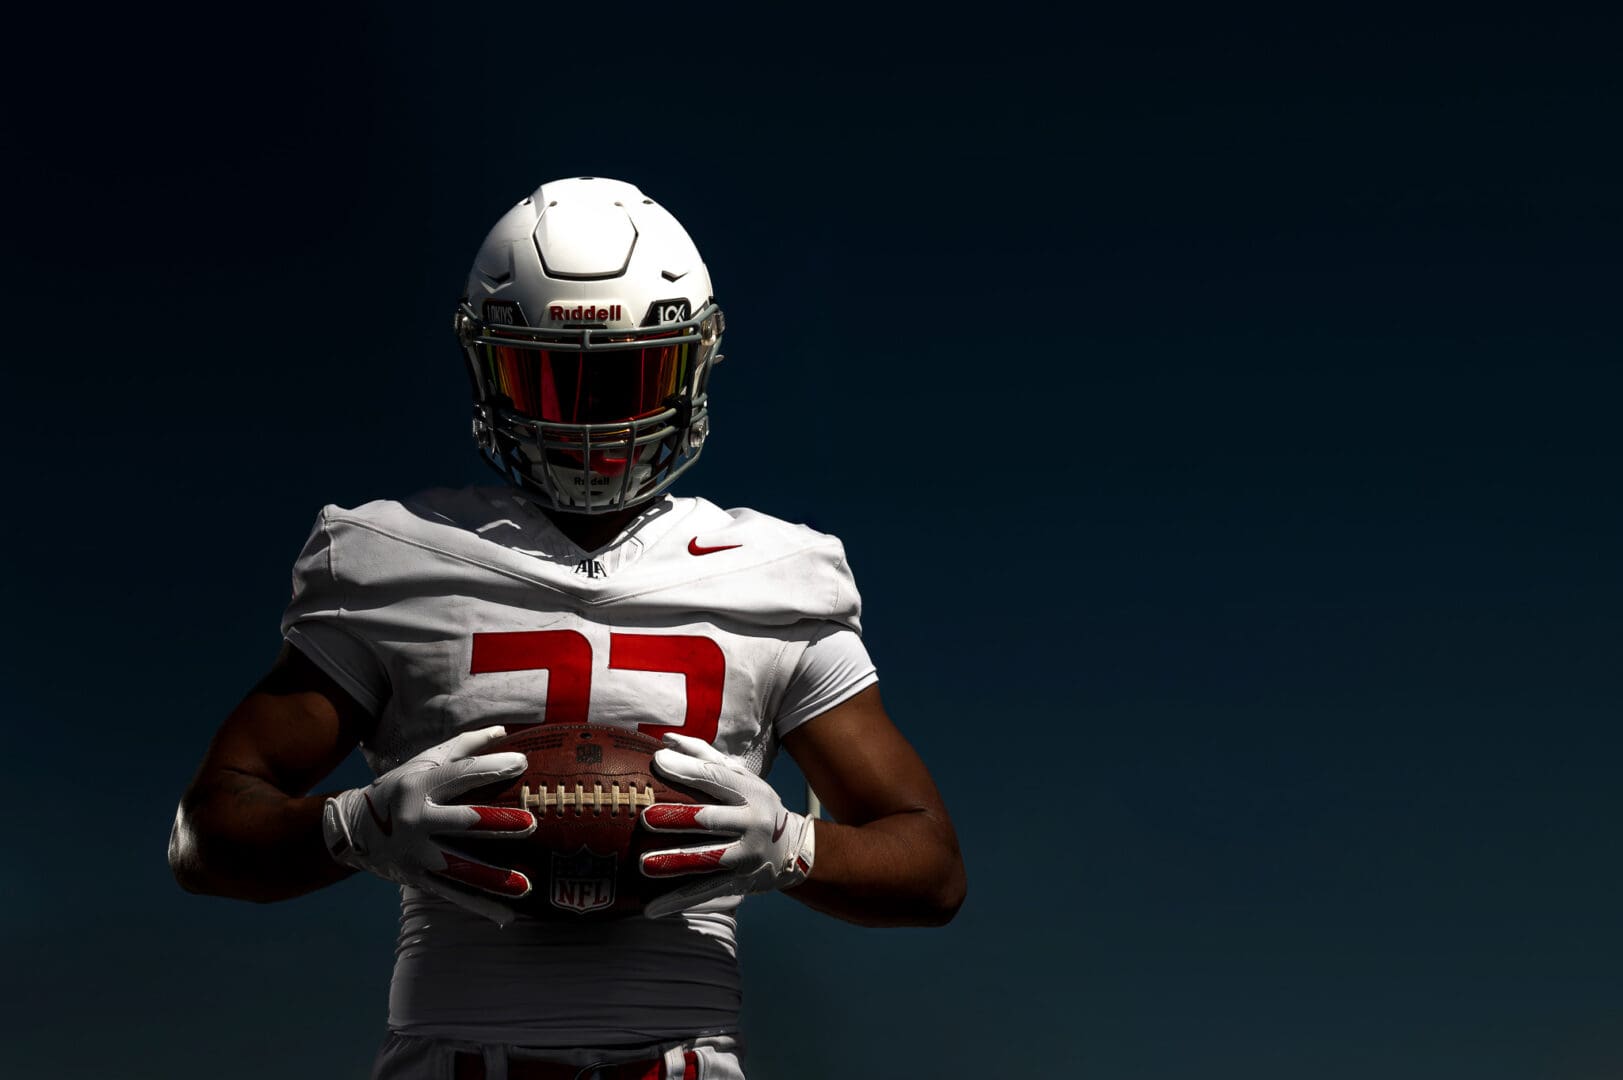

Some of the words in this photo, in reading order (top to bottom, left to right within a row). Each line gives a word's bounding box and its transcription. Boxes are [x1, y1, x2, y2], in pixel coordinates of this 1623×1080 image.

[550, 305, 622, 321] Riddell
[574, 477, 610, 486] Ridell
[558, 879, 609, 907] NFL
